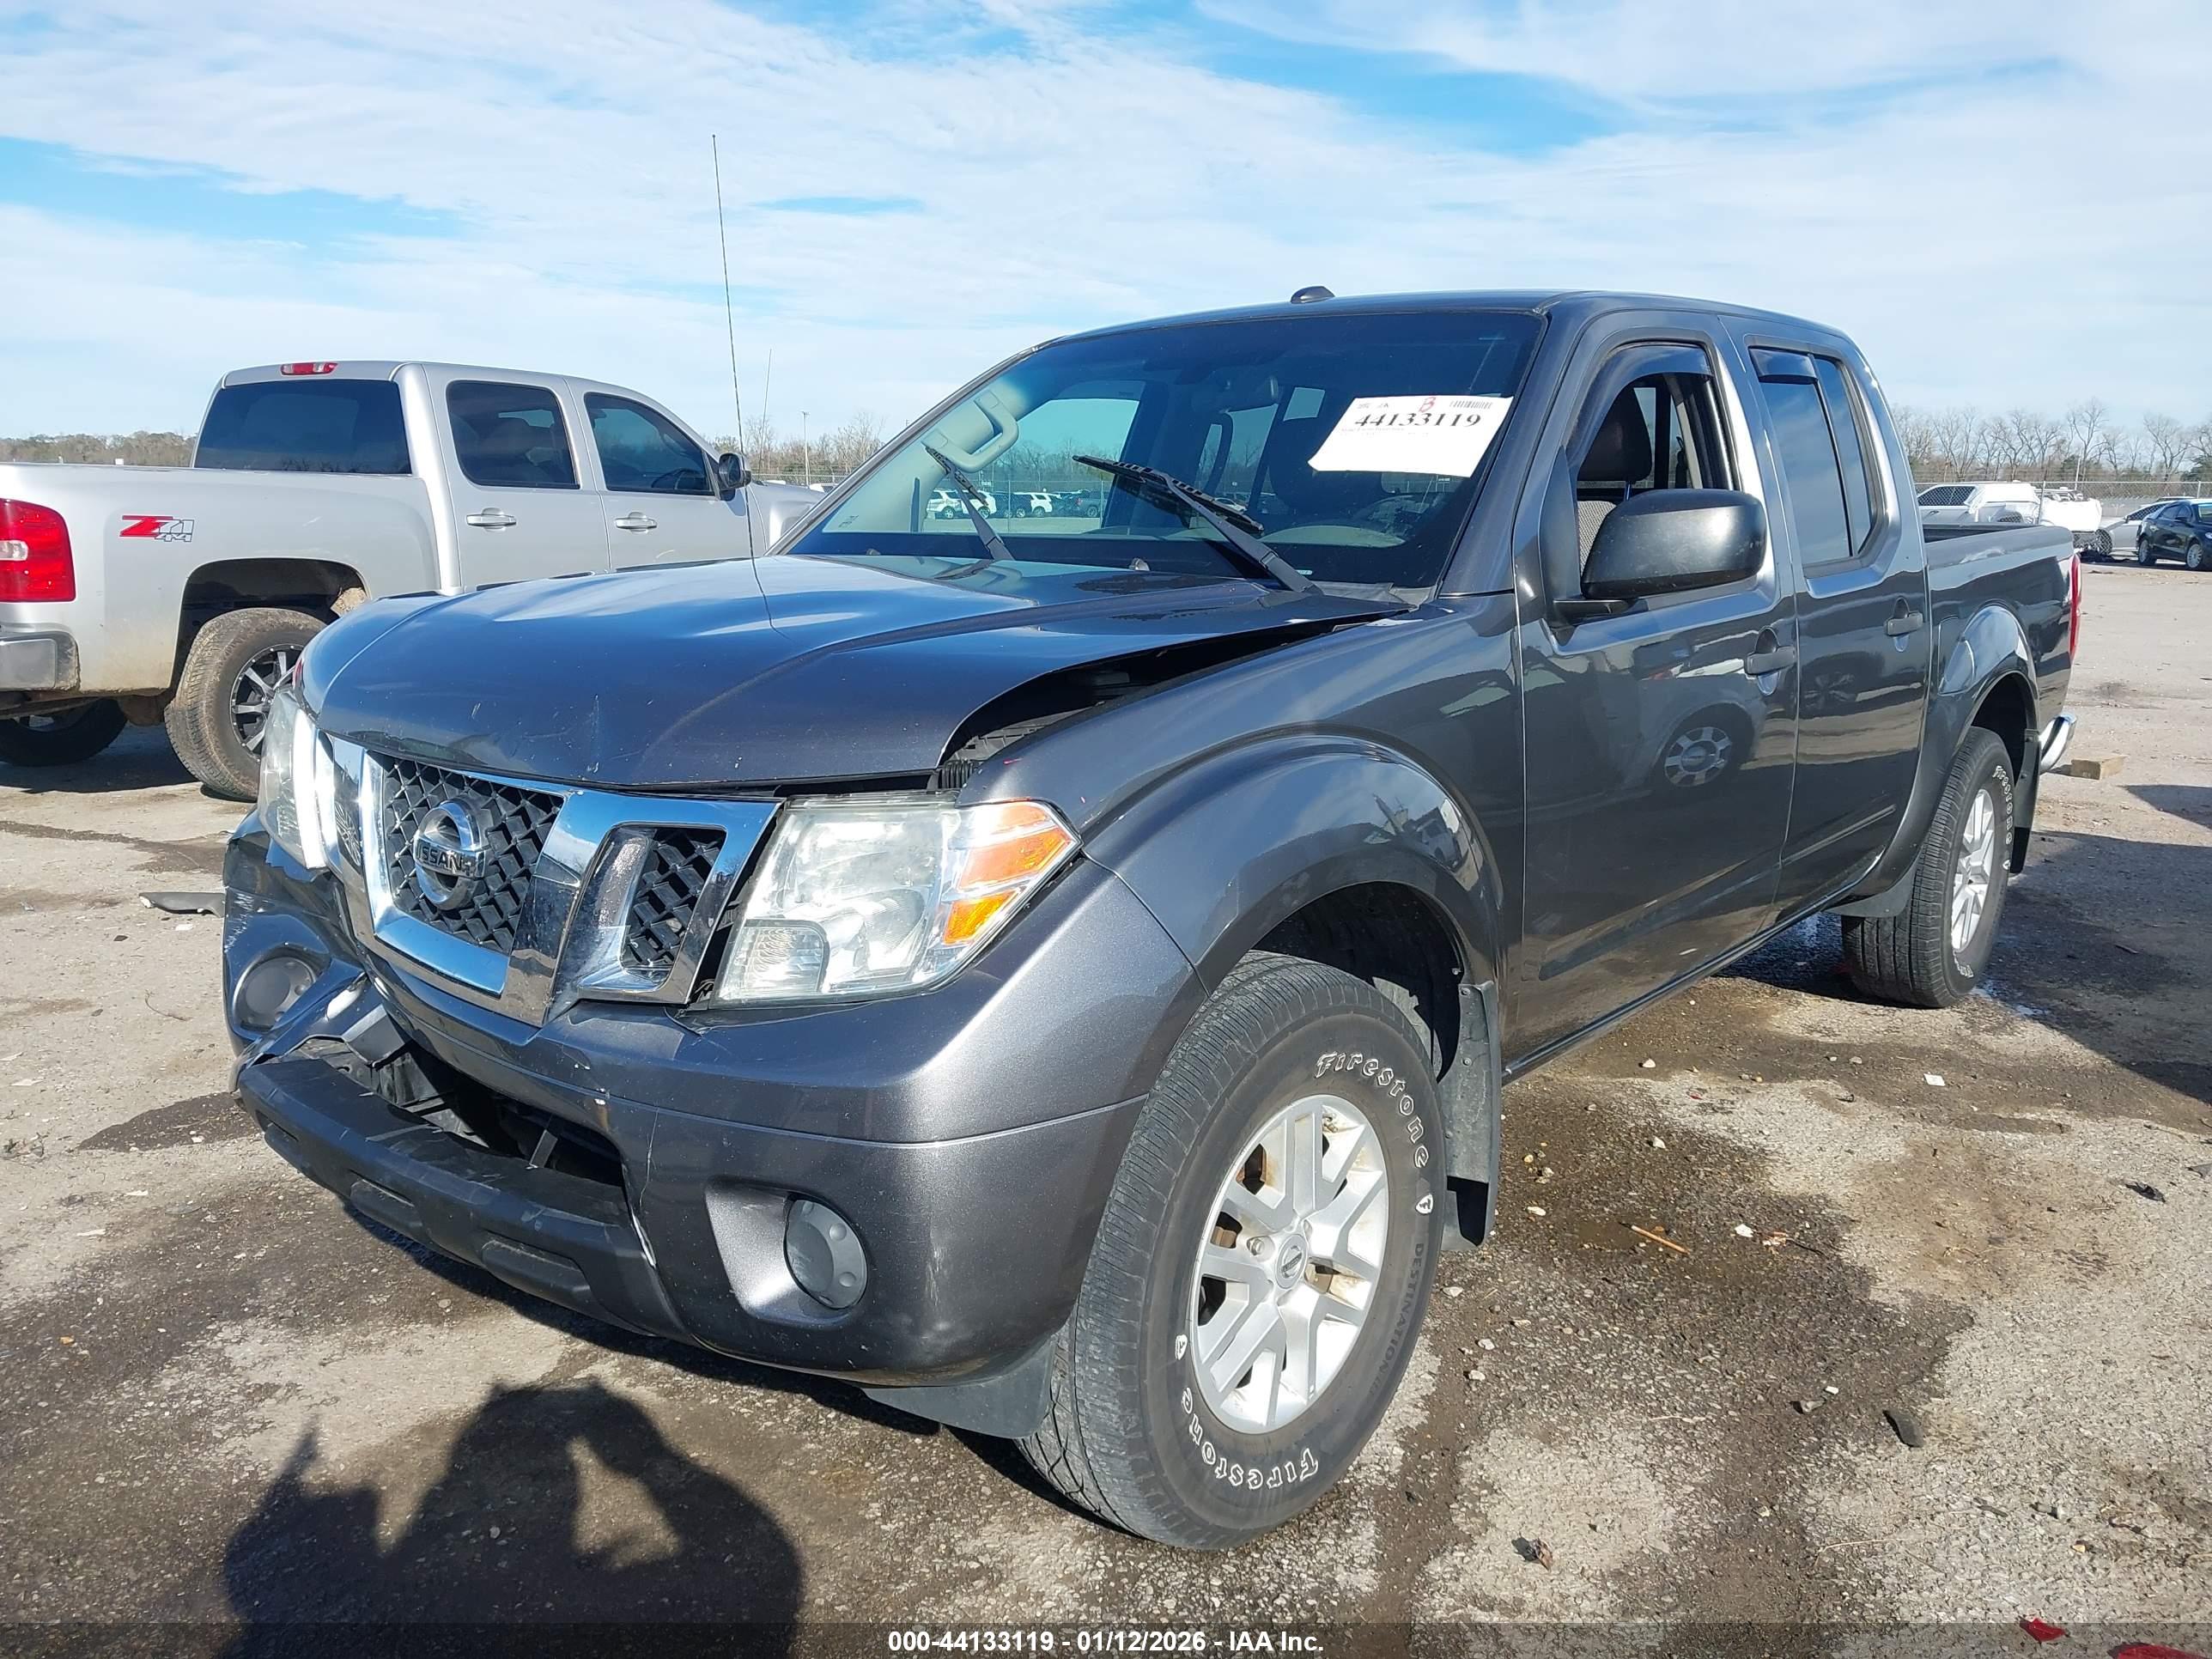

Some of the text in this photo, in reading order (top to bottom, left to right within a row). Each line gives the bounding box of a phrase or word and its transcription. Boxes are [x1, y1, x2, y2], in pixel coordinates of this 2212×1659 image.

[1354, 412, 1482, 428] 44133119
[119, 515, 195, 538] Z71
[1315, 1050, 1430, 1169] Firestone
[1378, 1243, 1425, 1374] DESTINATION
[1181, 1387, 1319, 1490] Firestone
